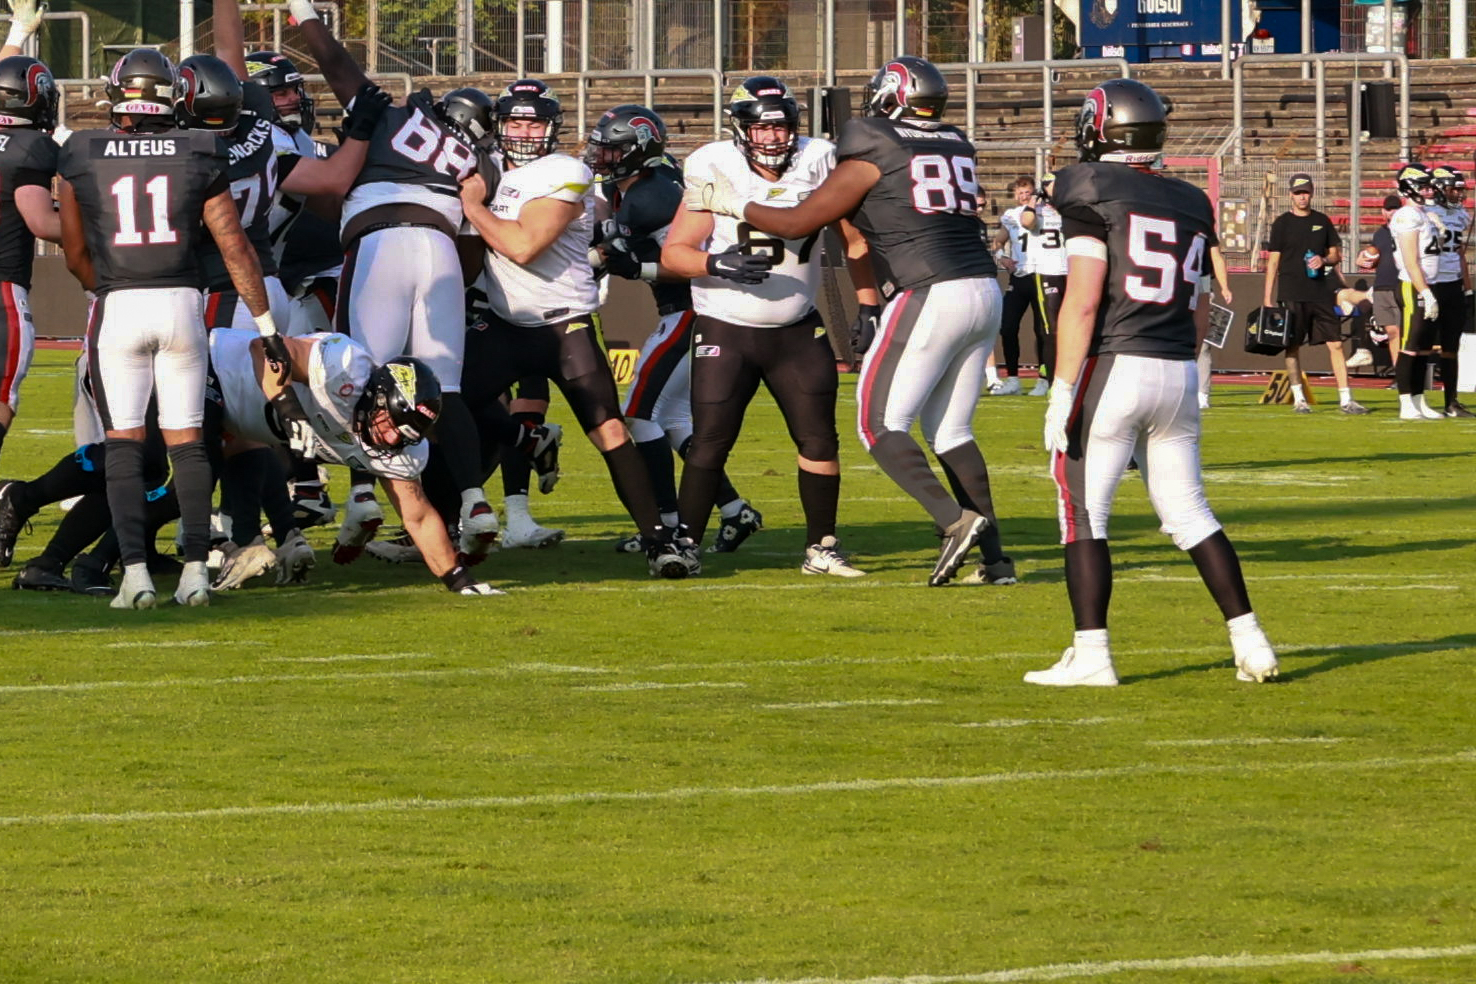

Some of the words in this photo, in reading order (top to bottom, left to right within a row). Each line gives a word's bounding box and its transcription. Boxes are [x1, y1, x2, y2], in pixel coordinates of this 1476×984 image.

[104, 140, 176, 156] ALTEUS
[111, 175, 177, 245] 11
[910, 154, 978, 215] 89
[1124, 213, 1206, 311] 54
[1264, 373, 1291, 403] 50
